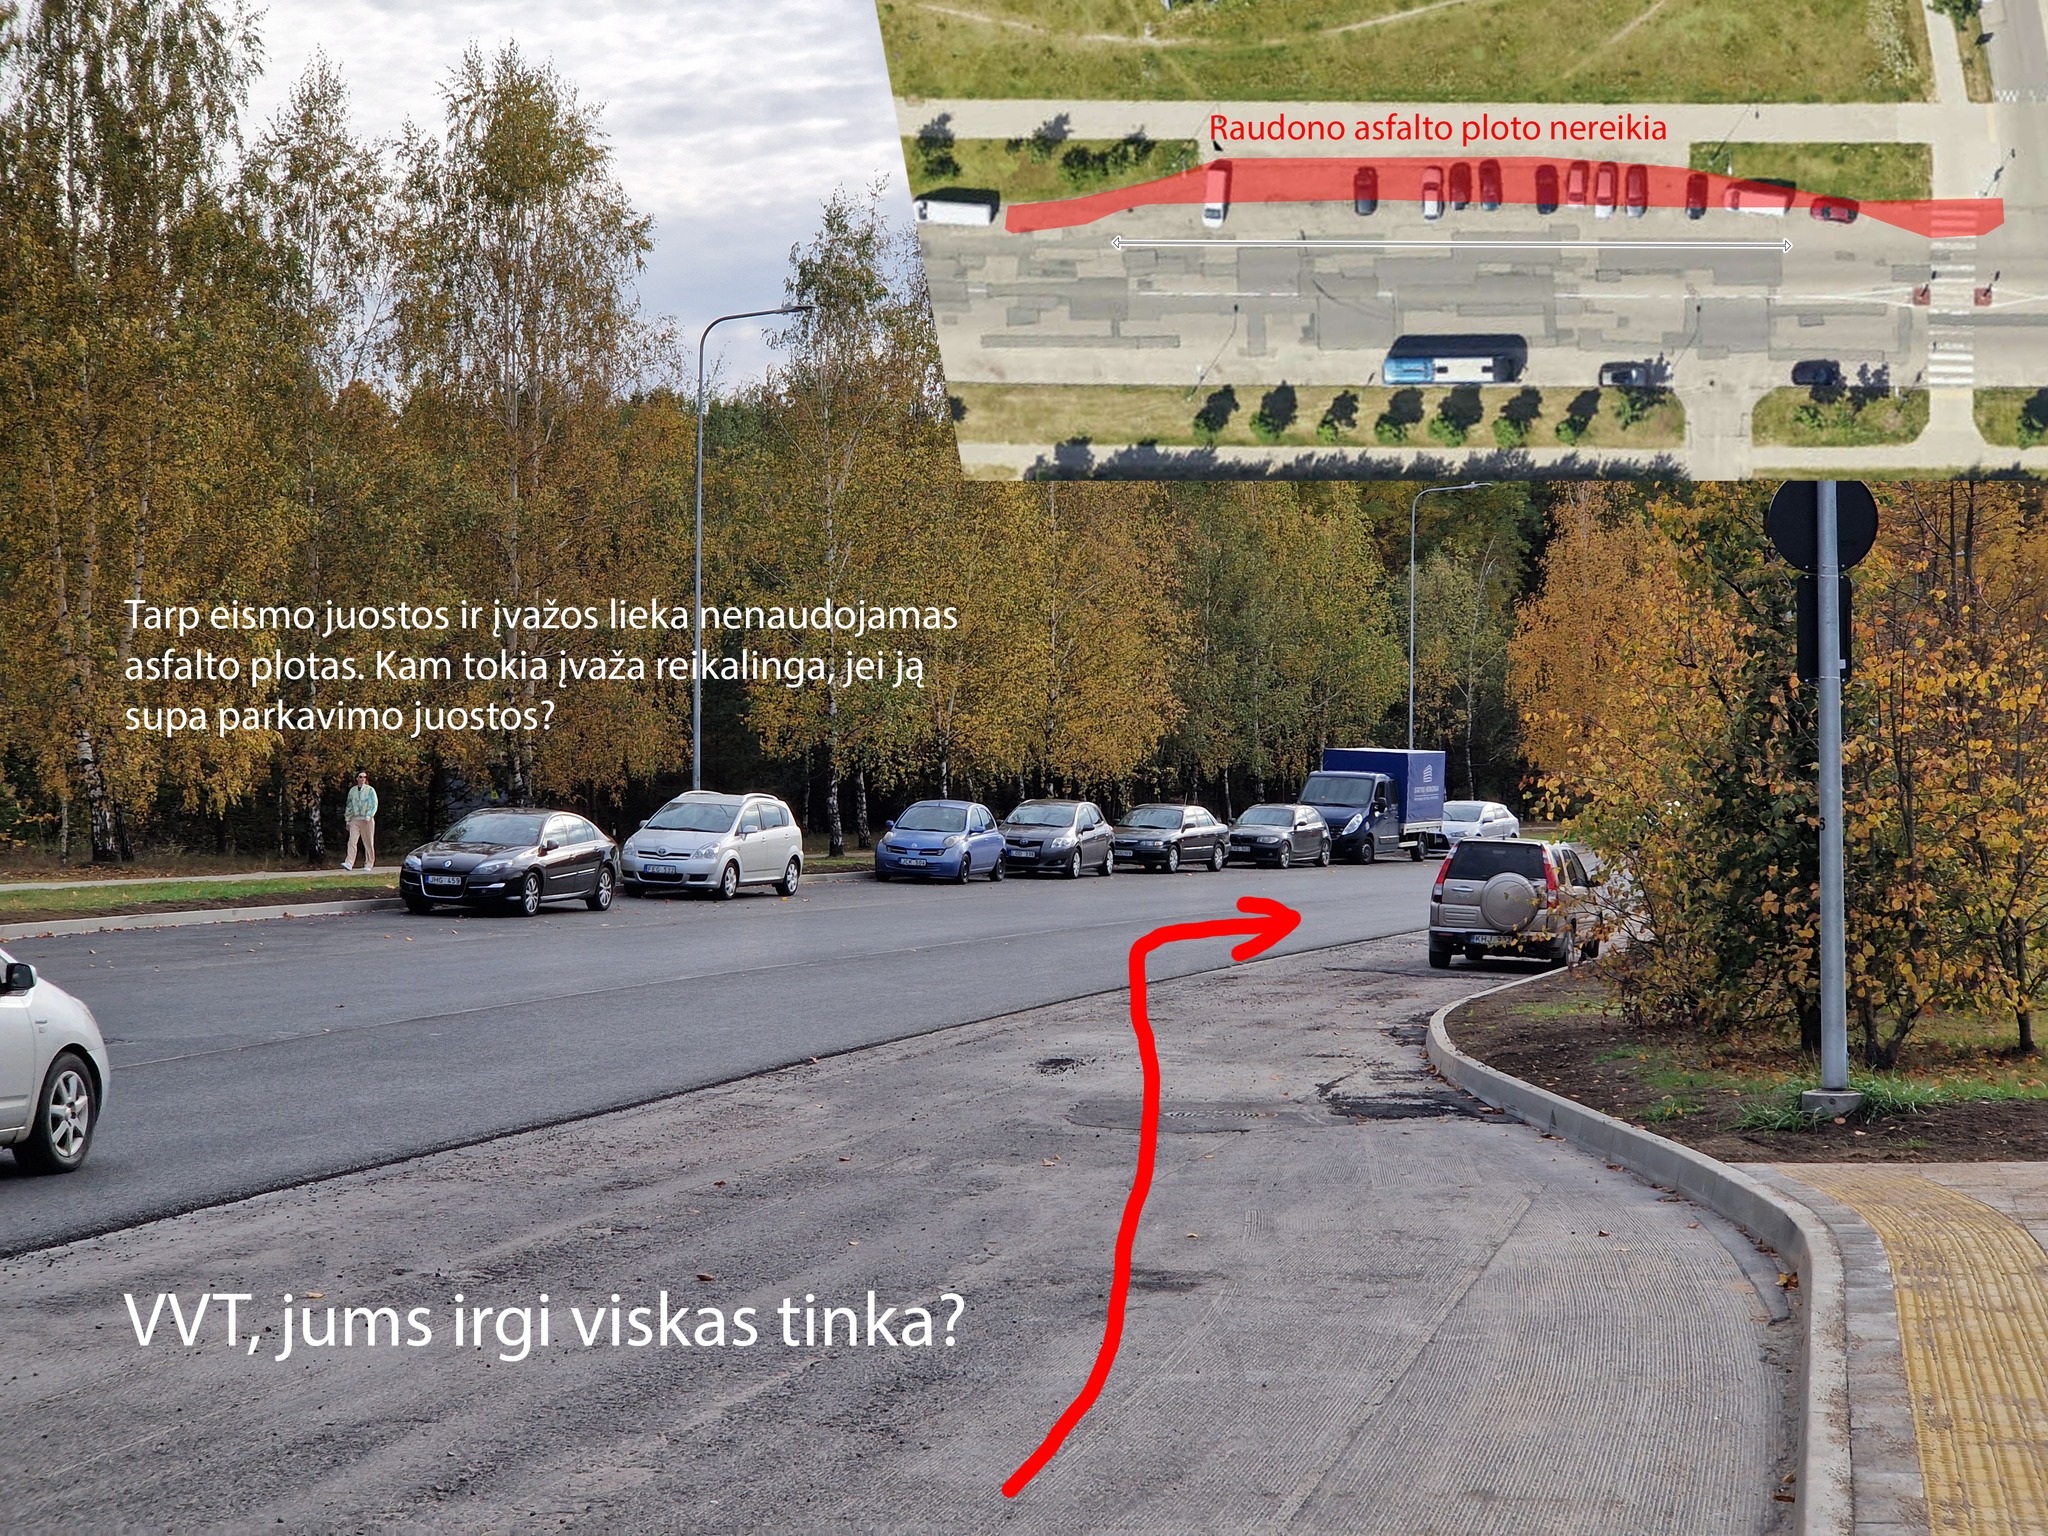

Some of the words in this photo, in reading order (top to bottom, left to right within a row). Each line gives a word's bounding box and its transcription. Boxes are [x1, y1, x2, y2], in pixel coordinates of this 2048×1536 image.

[429, 875, 444, 884] JHG
[447, 876, 461, 885] 459
[1475, 935, 1493, 944] KHJ
